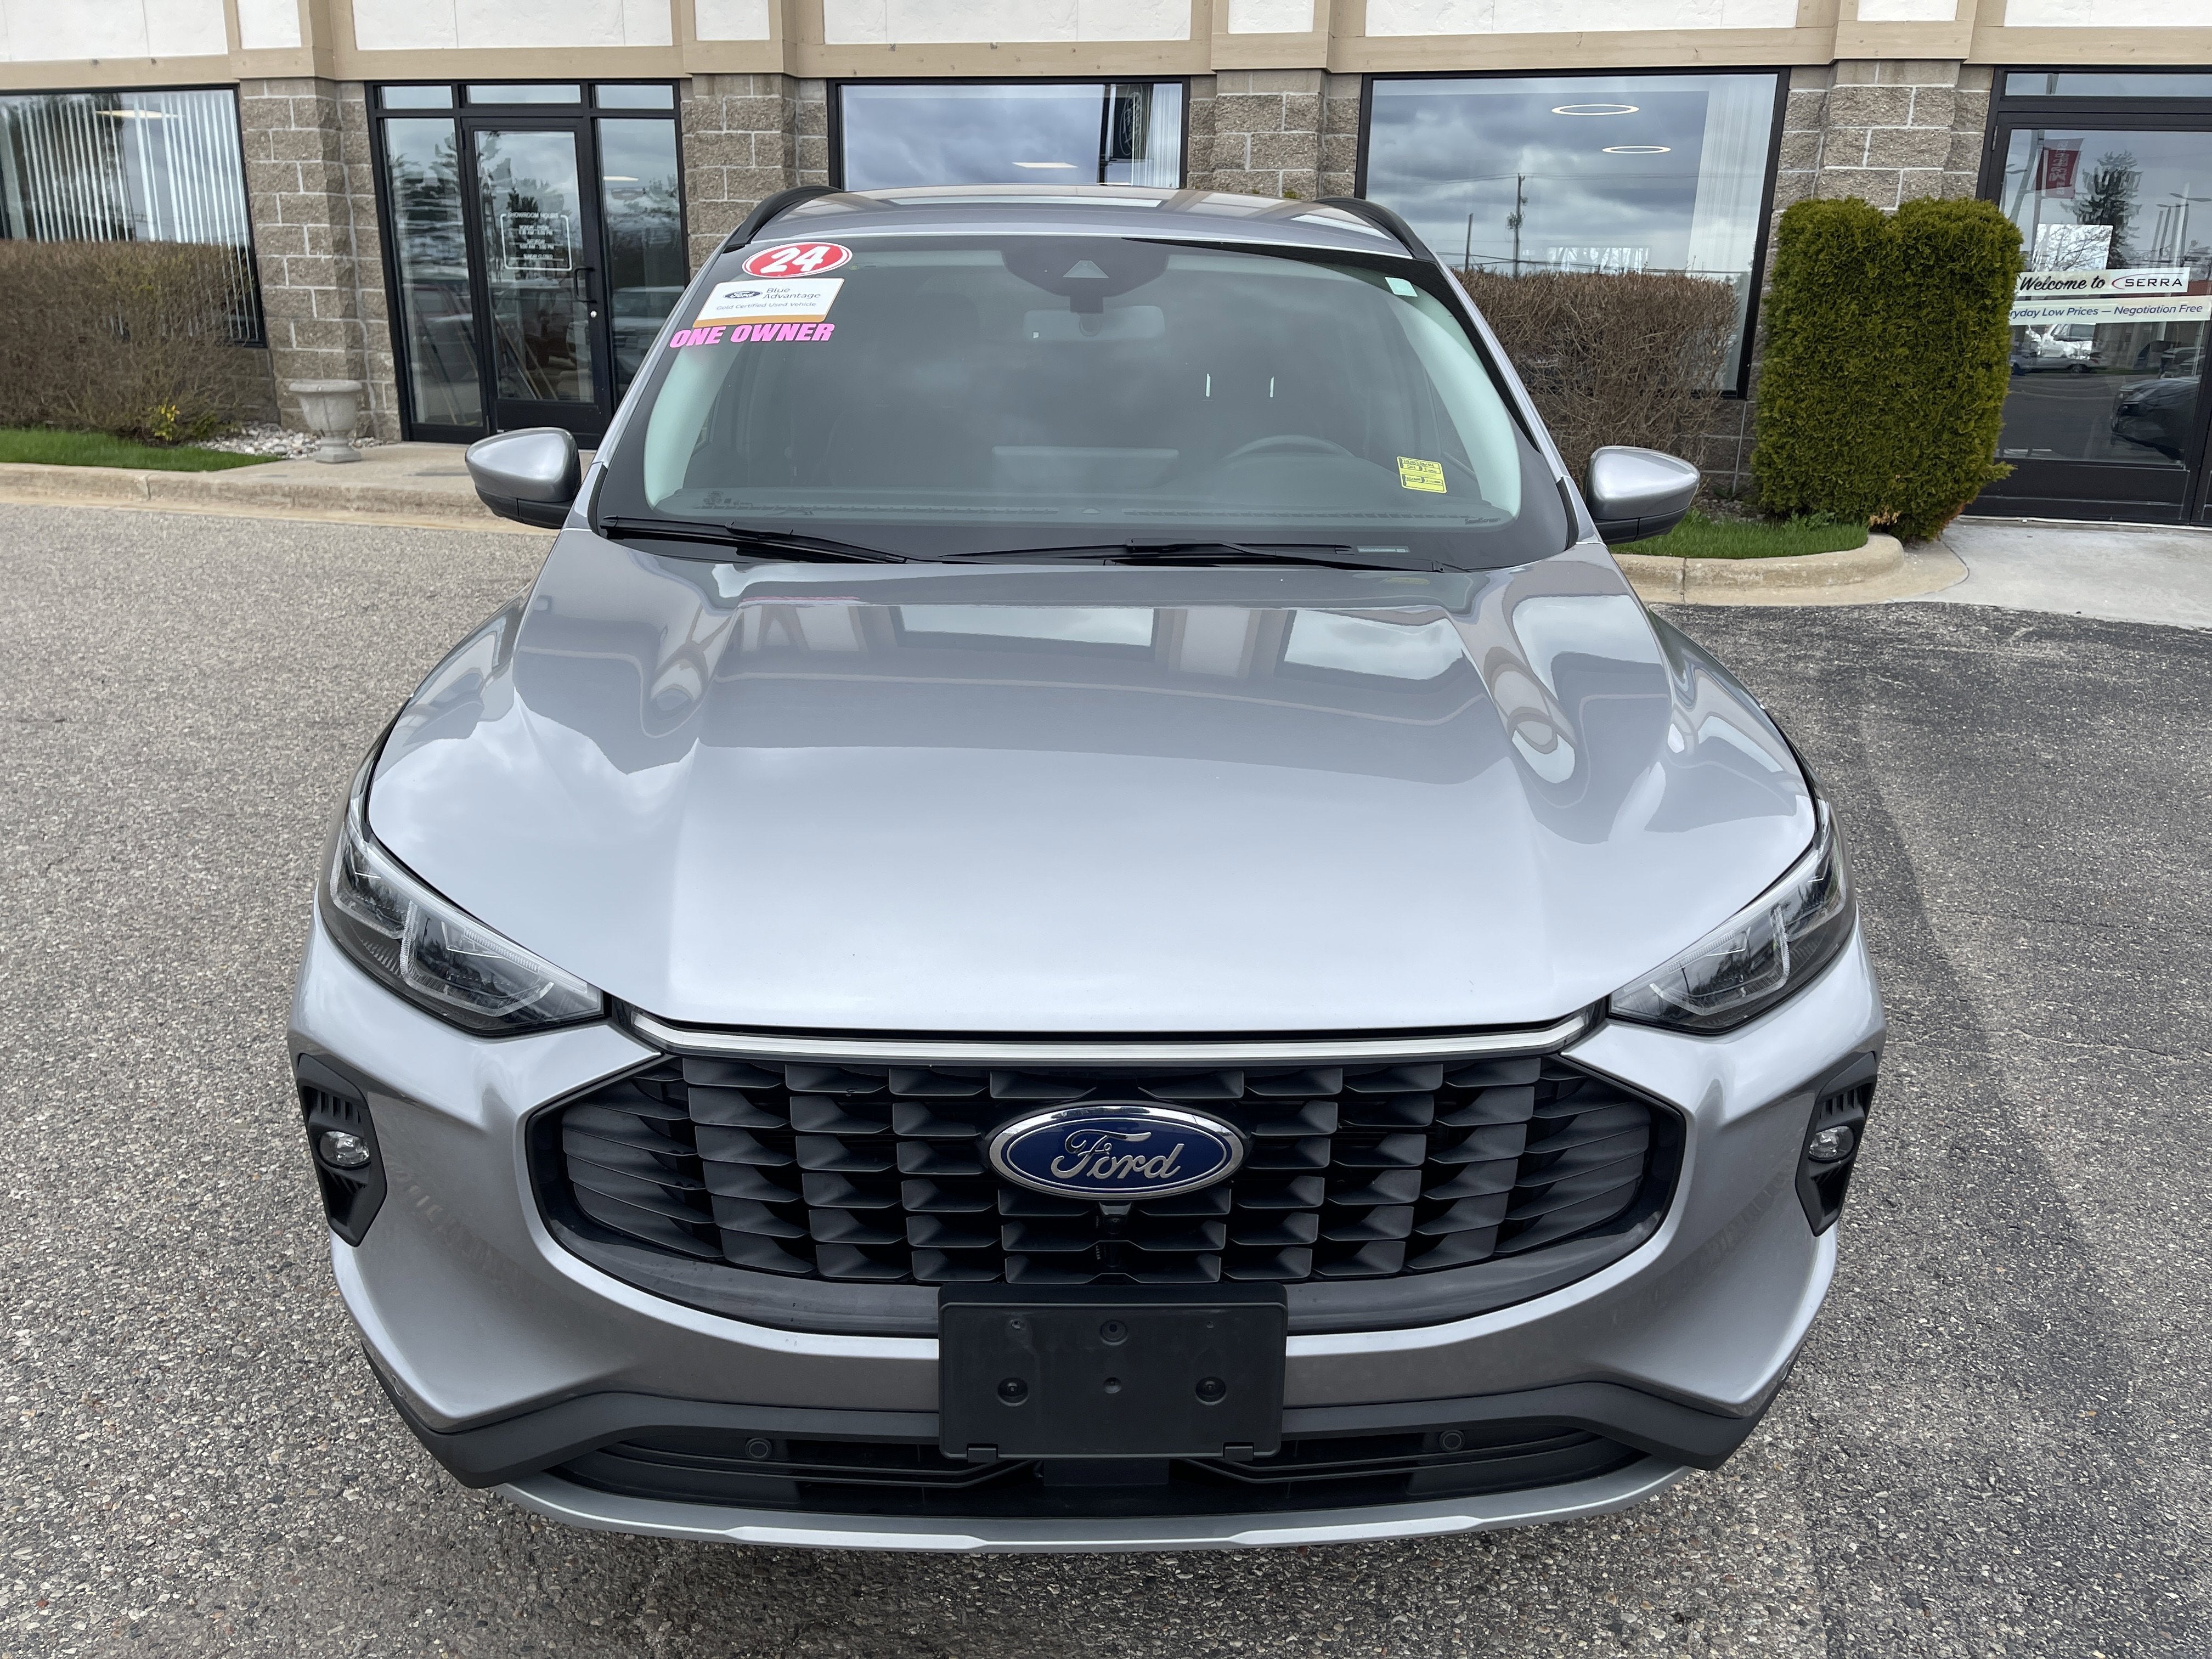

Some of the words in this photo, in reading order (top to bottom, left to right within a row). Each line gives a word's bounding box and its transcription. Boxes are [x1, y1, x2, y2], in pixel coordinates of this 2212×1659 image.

[760, 246, 831, 273] 24
[2019, 275, 2087, 291] Welcome
[2091, 275, 2106, 289] to
[2125, 278, 2183, 287] SERRA
[2010, 308, 2040, 319] ryday
[2042, 308, 2064, 317] Low
[2067, 307, 2098, 316] Prices
[2114, 304, 2176, 316] Negotiation
[2179, 304, 2203, 313] Free
[669, 326, 726, 348] ONE
[730, 323, 836, 343] OWNER
[1050, 1128, 1185, 1180] Ford
